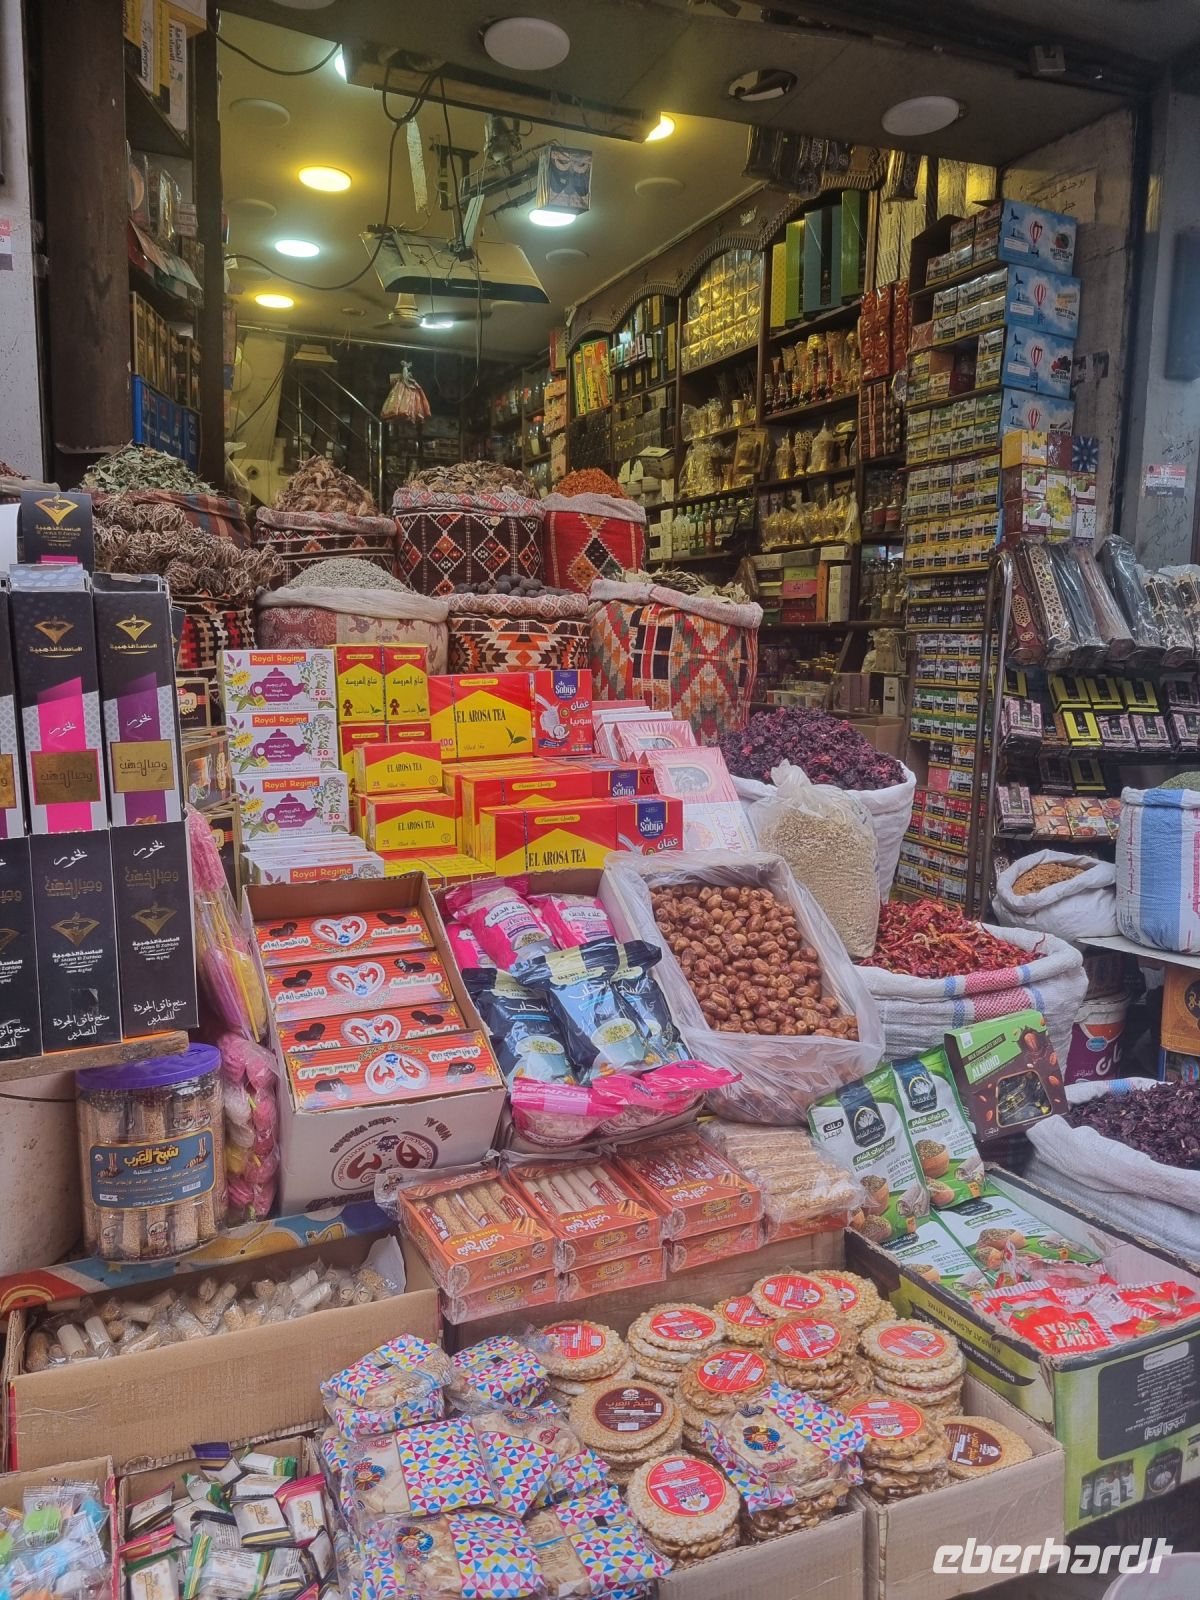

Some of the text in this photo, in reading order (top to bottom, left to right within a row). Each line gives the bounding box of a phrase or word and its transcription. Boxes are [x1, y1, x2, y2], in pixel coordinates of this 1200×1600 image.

[251, 654, 305, 663] Royal Regime
[555, 685, 576, 695] Sobya
[254, 715, 307, 724] Royal Regime
[456, 708, 506, 723] EL AROSA TEA
[387, 762, 422, 773] EL AROSA TEA
[264, 780, 318, 790] Royal Regime
[612, 786, 635, 797] Sobya
[398, 820, 435, 831] EL AROSA TEA
[640, 821, 664, 833] Sobya
[529, 849, 586, 867] EL AROSA TEA
[292, 867, 352, 878] Royal Regime
[134, 1001, 156, 1015] الجودة
[157, 998, 173, 1013] فائق
[53, 1015, 77, 1029] الجودة
[81, 1012, 96, 1026] فائق
[147, 1011, 175, 1026] للتصدير
[68, 1025, 97, 1040] للتصدير
[971, 1055, 1000, 1080] ALMOND
[124, 1145, 179, 1167] شيخ العرب
[690, 1185, 714, 1198] العرب
[585, 1214, 612, 1230] العرب
[479, 1234, 504, 1252] العرب
[990, 1360, 1015, 1383] Delicious
